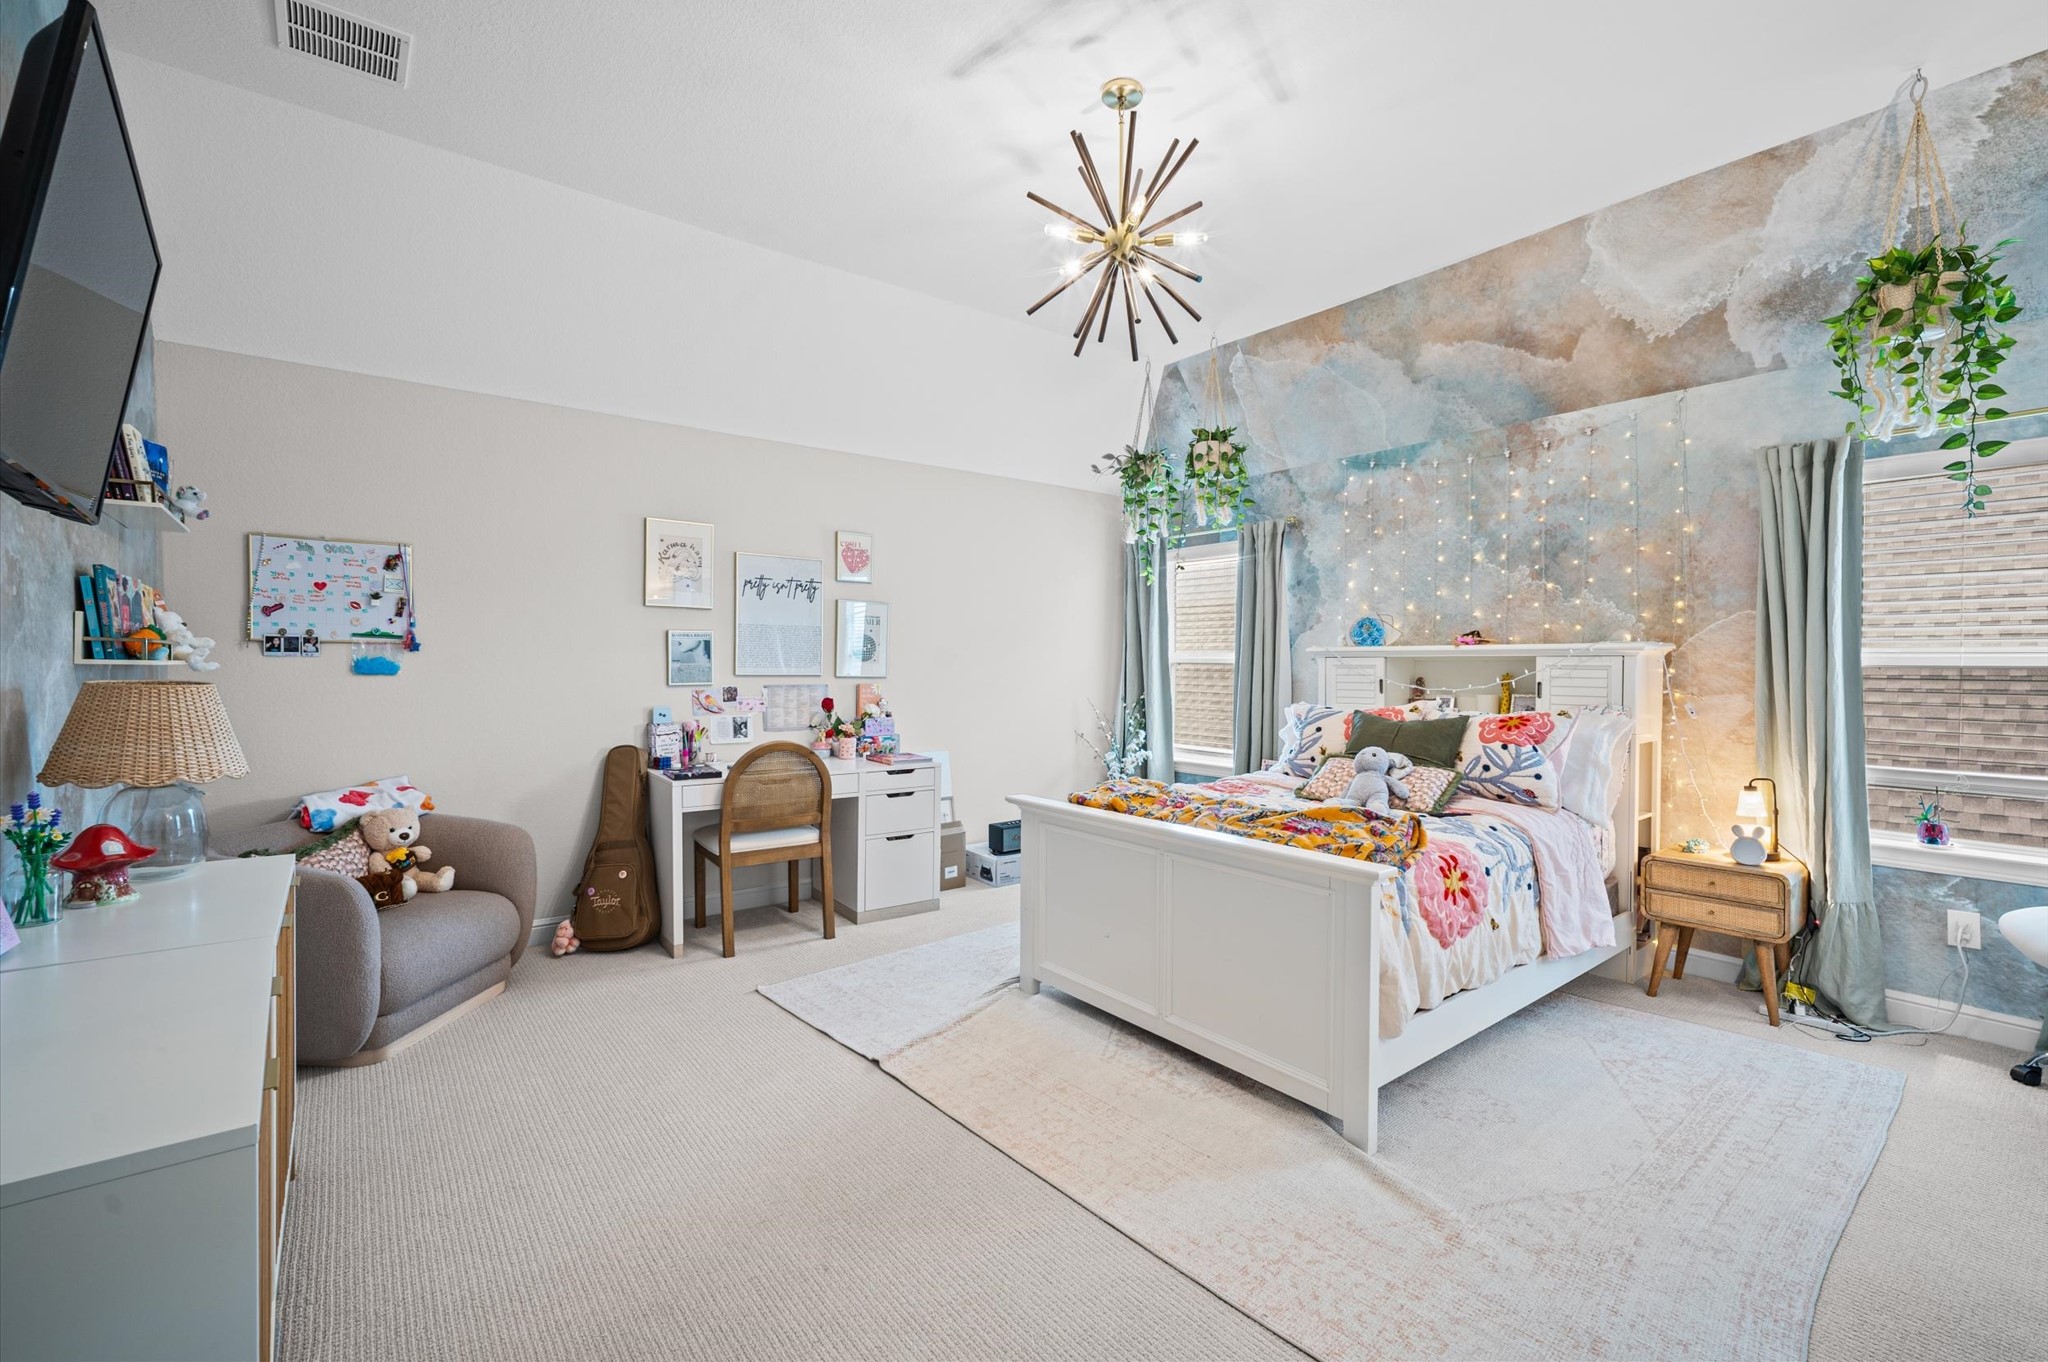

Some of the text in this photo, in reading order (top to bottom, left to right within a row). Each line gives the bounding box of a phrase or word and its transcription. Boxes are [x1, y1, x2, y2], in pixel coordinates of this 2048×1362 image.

[658, 541, 687, 565] Karma
[742, 574, 822, 603] pretty isn't pretty
[590, 895, 621, 909] Taylor
